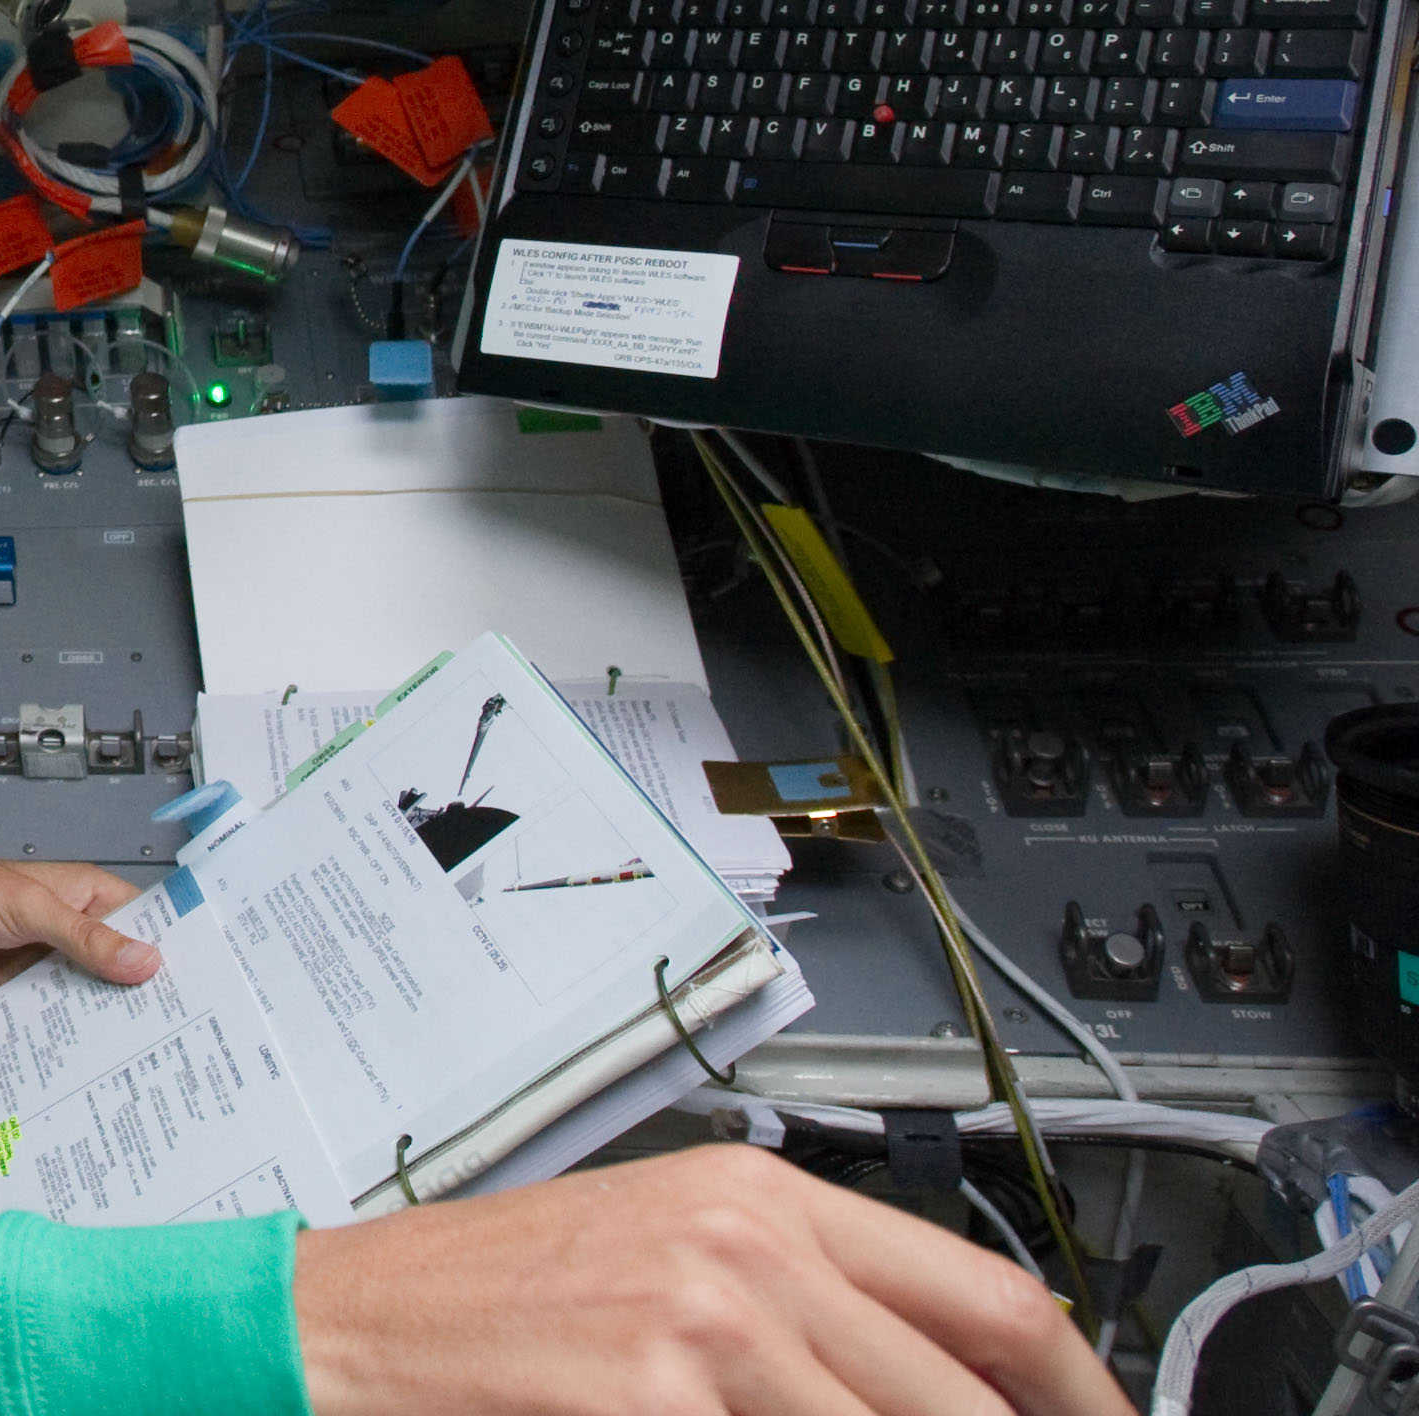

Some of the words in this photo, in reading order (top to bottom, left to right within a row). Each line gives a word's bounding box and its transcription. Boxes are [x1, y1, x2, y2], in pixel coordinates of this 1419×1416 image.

[661, 32, 674, 45] Q
[705, 32, 722, 44] W
[749, 33, 762, 45] E
[796, 33, 809, 45] R
[846, 33, 858, 45] T
[895, 33, 907, 45] Y
[943, 34, 957, 46] U
[1049, 33, 1064, 47] O
[1104, 33, 1119, 47] P
[662, 75, 675, 88] A
[707, 75, 718, 88] S
[752, 76, 764, 88] D
[798, 77, 811, 90] F
[847, 79, 862, 92] G
[896, 79, 911, 92] H
[947, 80, 959, 93] J
[999, 80, 1015, 94] K
[1053, 81, 1066, 95] L
[1255, 94, 1286, 103] Enter
[674, 118, 687, 131] Z
[719, 120, 733, 133] X
[767, 121, 779, 133] C
[815, 123, 828, 135] V
[862, 124, 876, 138] B
[911, 126, 927, 139] N
[963, 127, 981, 140] M
[1208, 143, 1236, 154] Shift
[1008, 186, 1024, 196] Alt
[1092, 189, 1112, 199] Ctrl
[512, 247, 539, 258] WLES
[541, 250, 577, 261] CONFIG
[579, 252, 611, 263] AFTER
[614, 255, 642, 265] PGSC
[644, 256, 687, 270] REBOOT
[1225, 396, 1280, 434] ThinkPad
[396, 665, 439, 702] EXTERIOR
[206, 819, 247, 853] NOMINAL
[1106, 835, 1168, 843] ANTENNA
[1105, 1010, 1133, 1019] OFF
[1230, 1009, 1273, 1020] STOW
